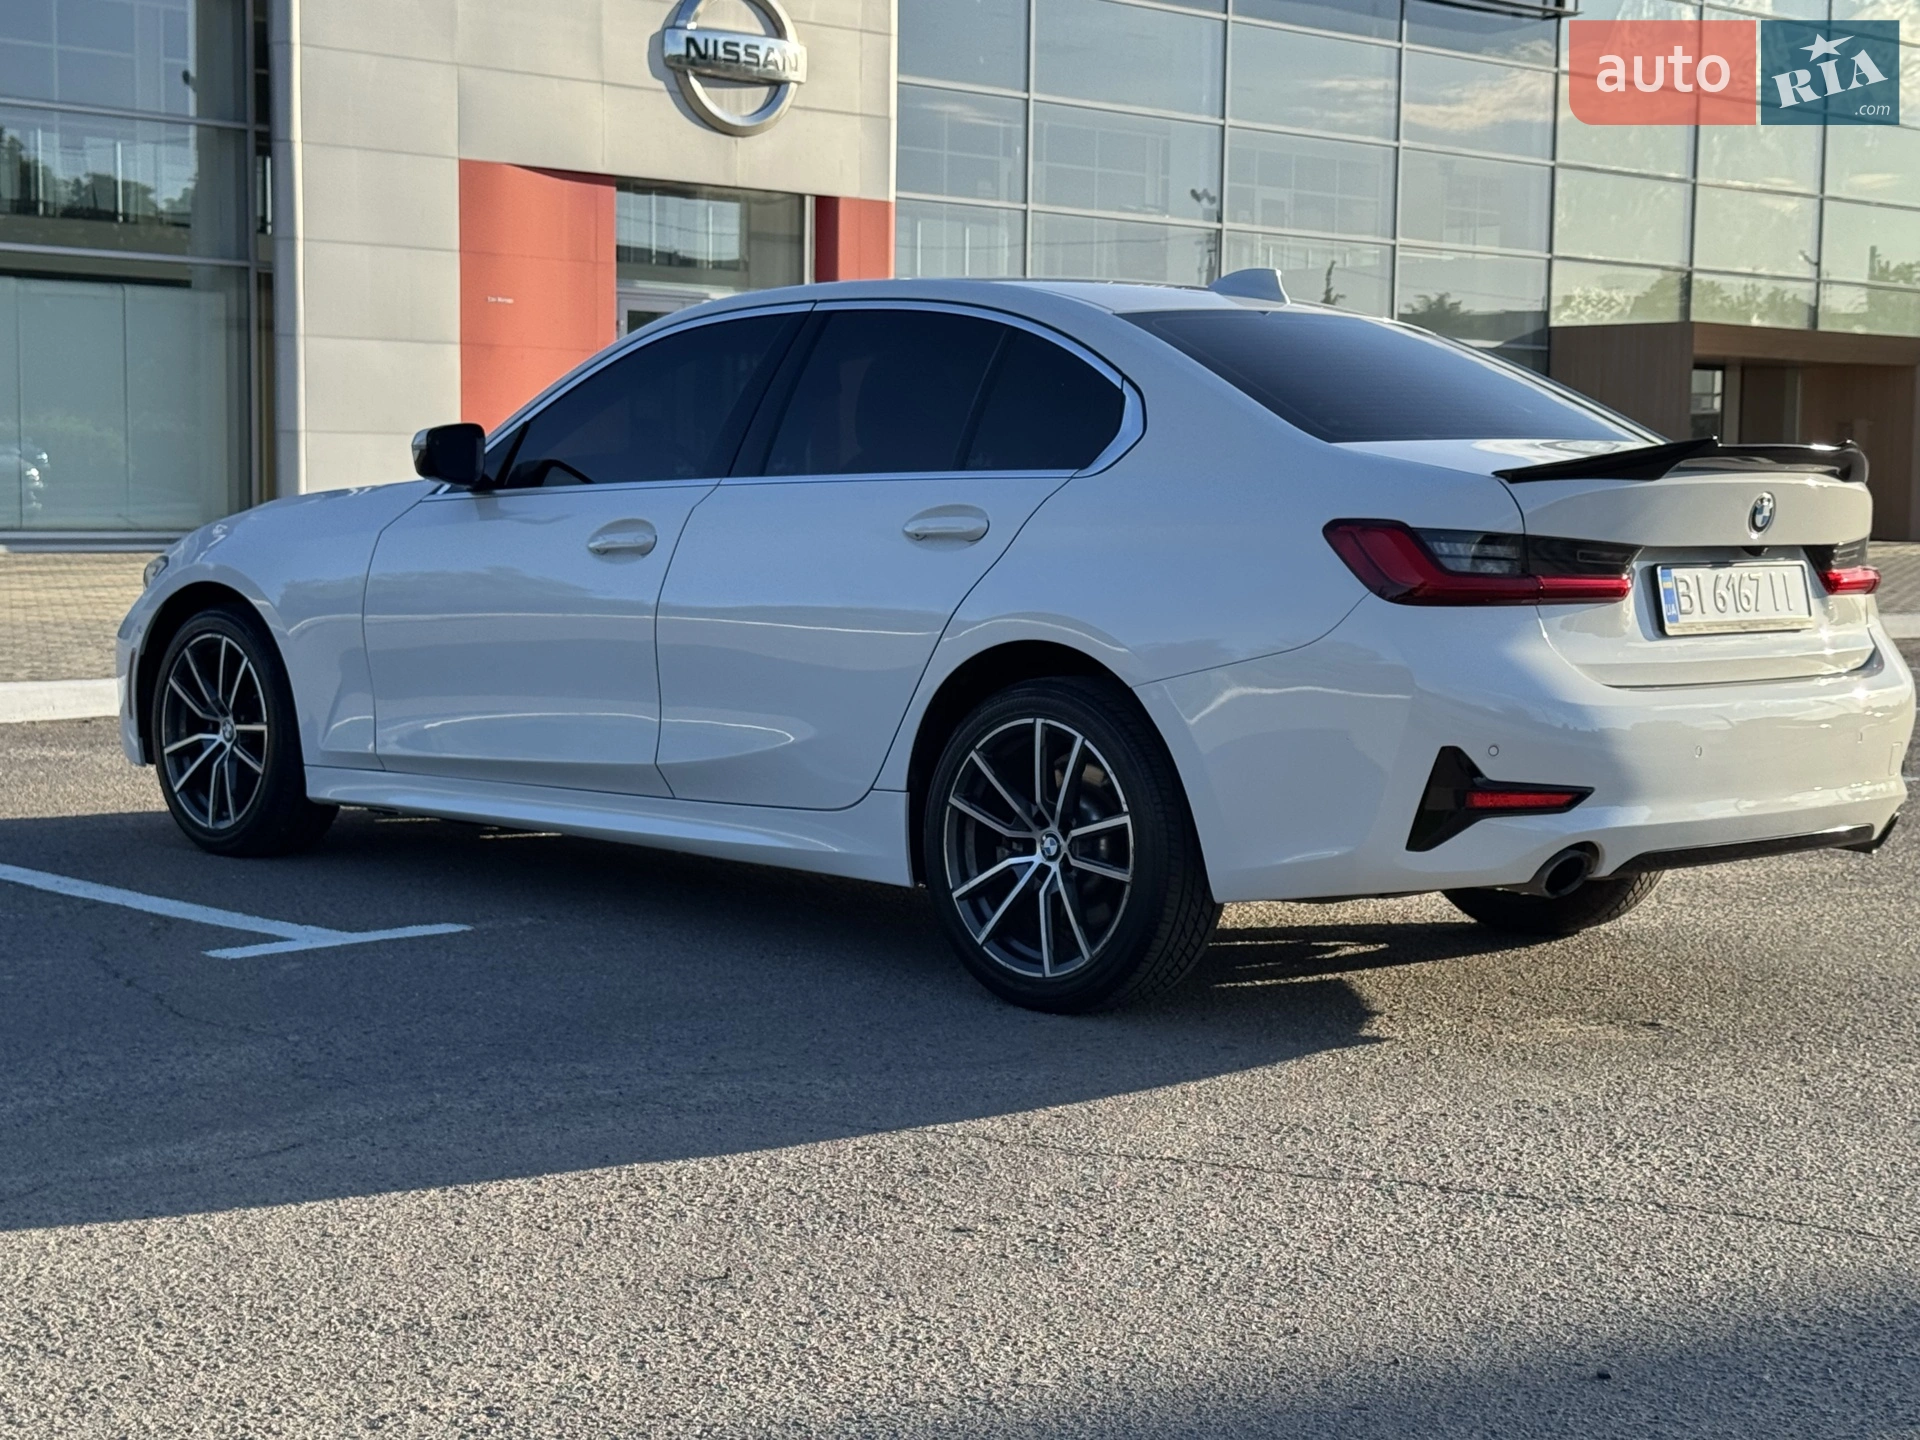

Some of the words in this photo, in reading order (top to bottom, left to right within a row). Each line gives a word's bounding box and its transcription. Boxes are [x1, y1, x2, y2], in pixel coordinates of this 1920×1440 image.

[685, 36, 799, 73] NISSAN
[1674, 573, 1706, 615] BI
[1713, 572, 1763, 613] 6167
